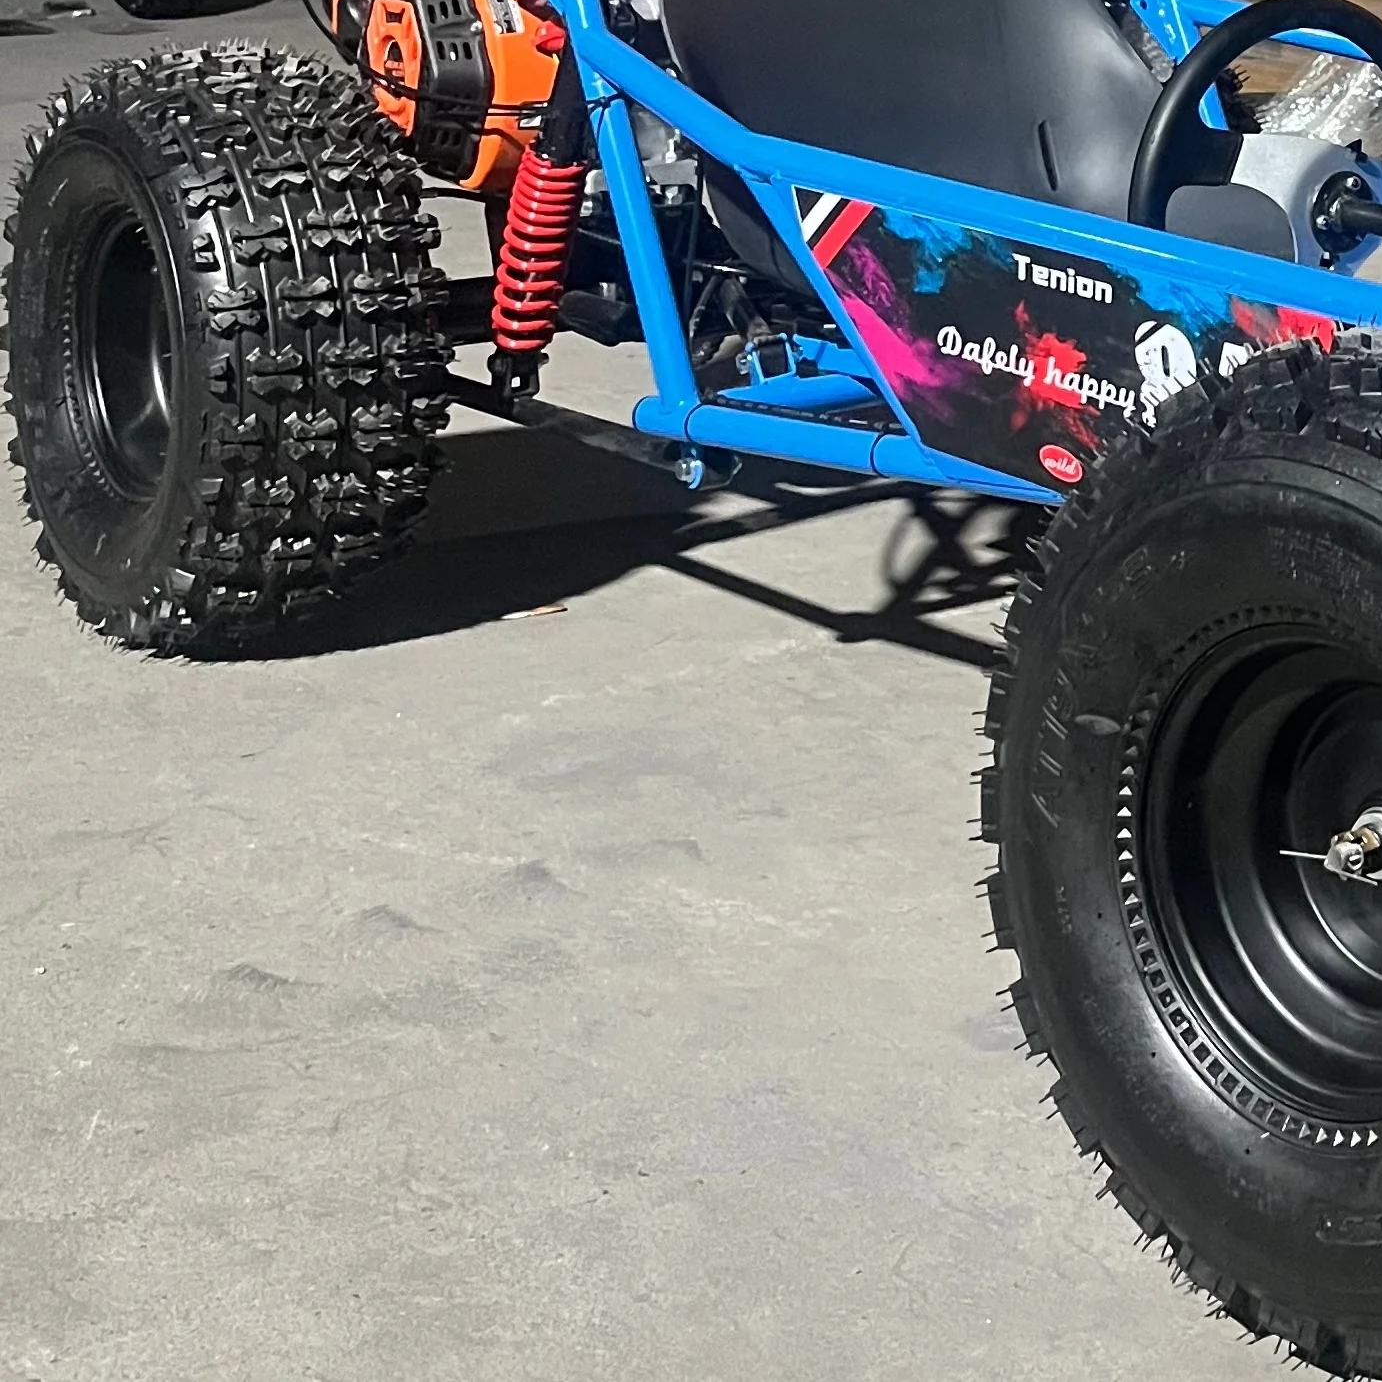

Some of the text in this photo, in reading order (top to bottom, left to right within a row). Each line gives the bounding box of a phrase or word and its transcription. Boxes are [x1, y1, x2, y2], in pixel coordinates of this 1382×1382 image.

[1012, 253, 1113, 304] Tenion
[1043, 356, 1137, 418] happy
[1043, 454, 1077, 475] wild
